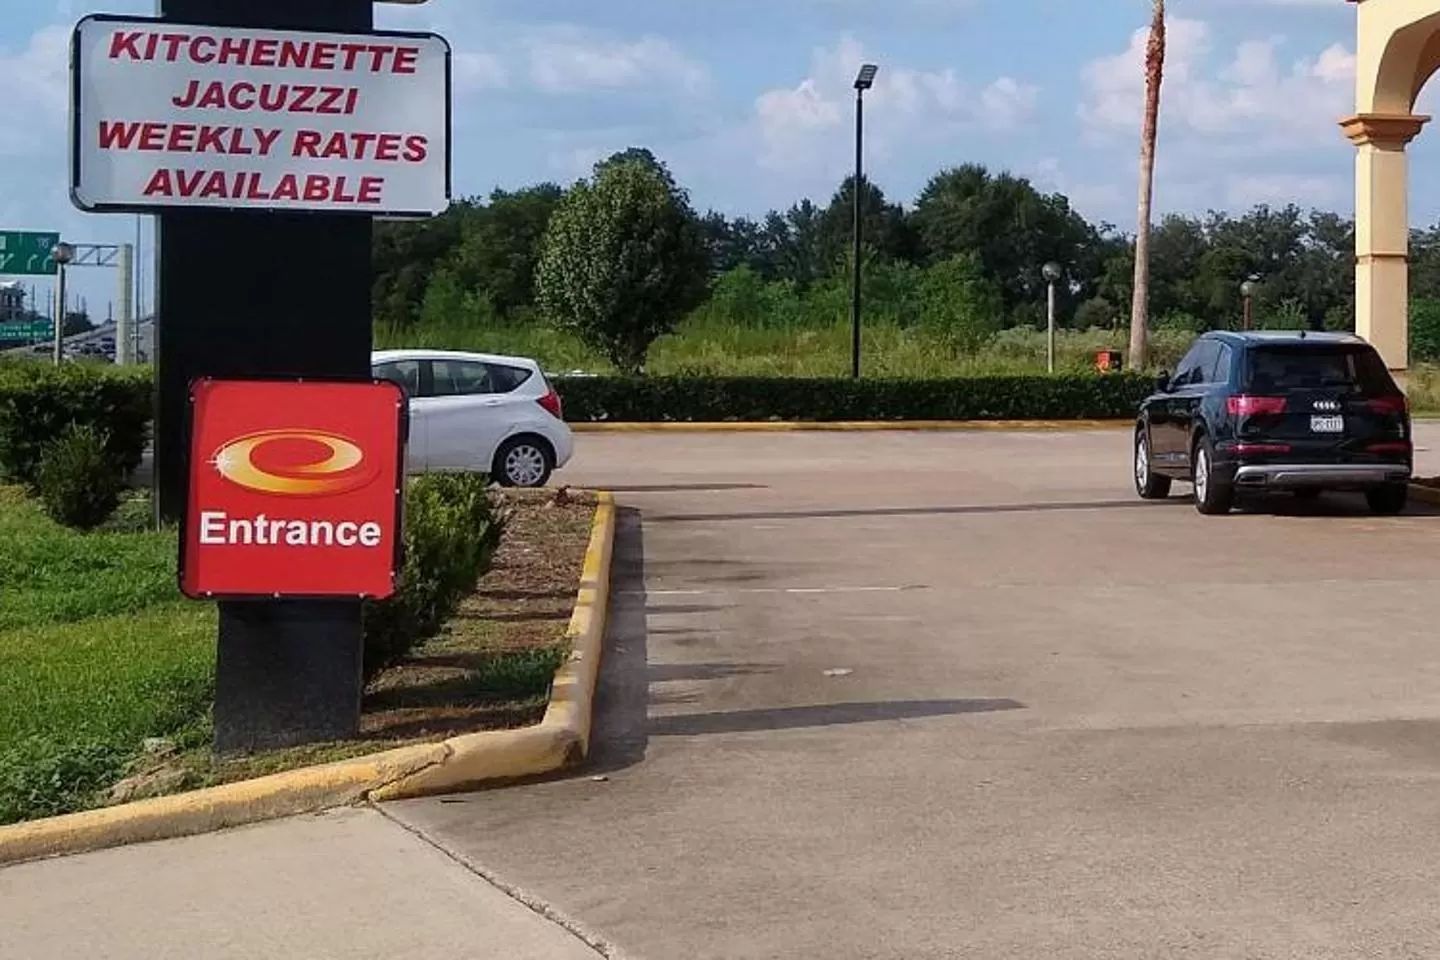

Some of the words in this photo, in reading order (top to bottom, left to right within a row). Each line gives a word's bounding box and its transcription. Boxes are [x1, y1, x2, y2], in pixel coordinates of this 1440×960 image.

[108, 30, 419, 74] KITCHENETTE
[171, 79, 359, 115] JACUZZI
[98, 120, 281, 156] WEEKLY
[292, 130, 428, 162] RATES
[143, 167, 385, 204] AVAILABLE
[200, 511, 381, 546] Entrance
